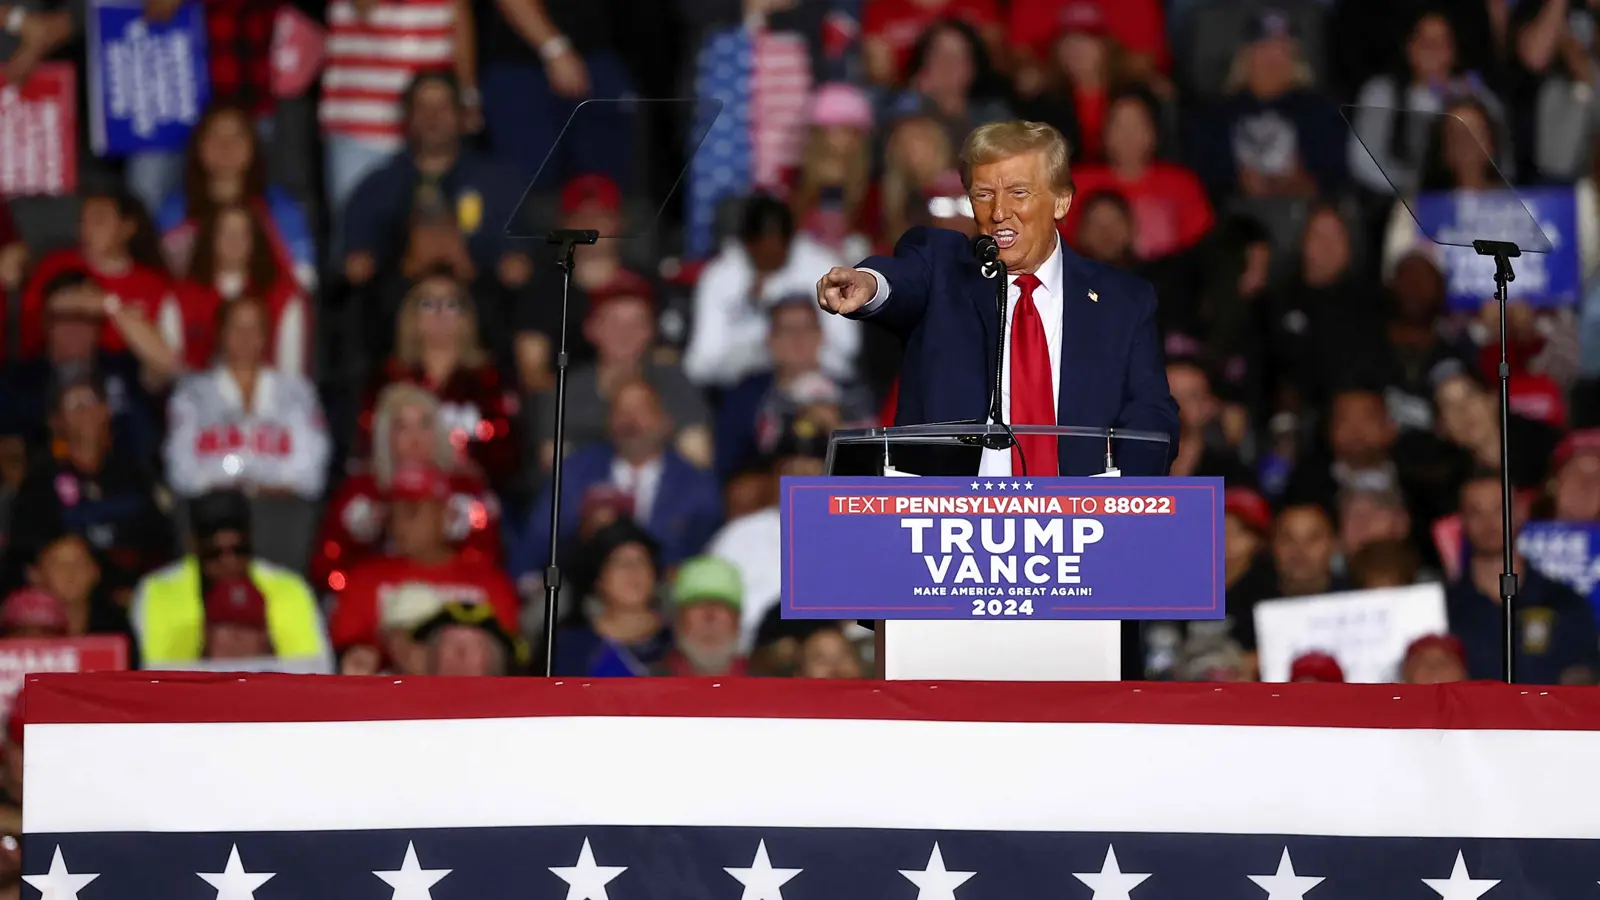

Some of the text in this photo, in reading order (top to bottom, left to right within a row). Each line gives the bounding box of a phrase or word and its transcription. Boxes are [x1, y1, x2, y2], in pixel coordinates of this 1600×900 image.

[834, 496, 1171, 514] TEXT PENNSYLVANIA TO 88022
[900, 518, 1105, 554] TRUMP
[923, 554, 1082, 584] VANCE
[913, 587, 1092, 596] MAKE AMERICA GREAT AGAIN!
[972, 599, 1034, 616] 2024
